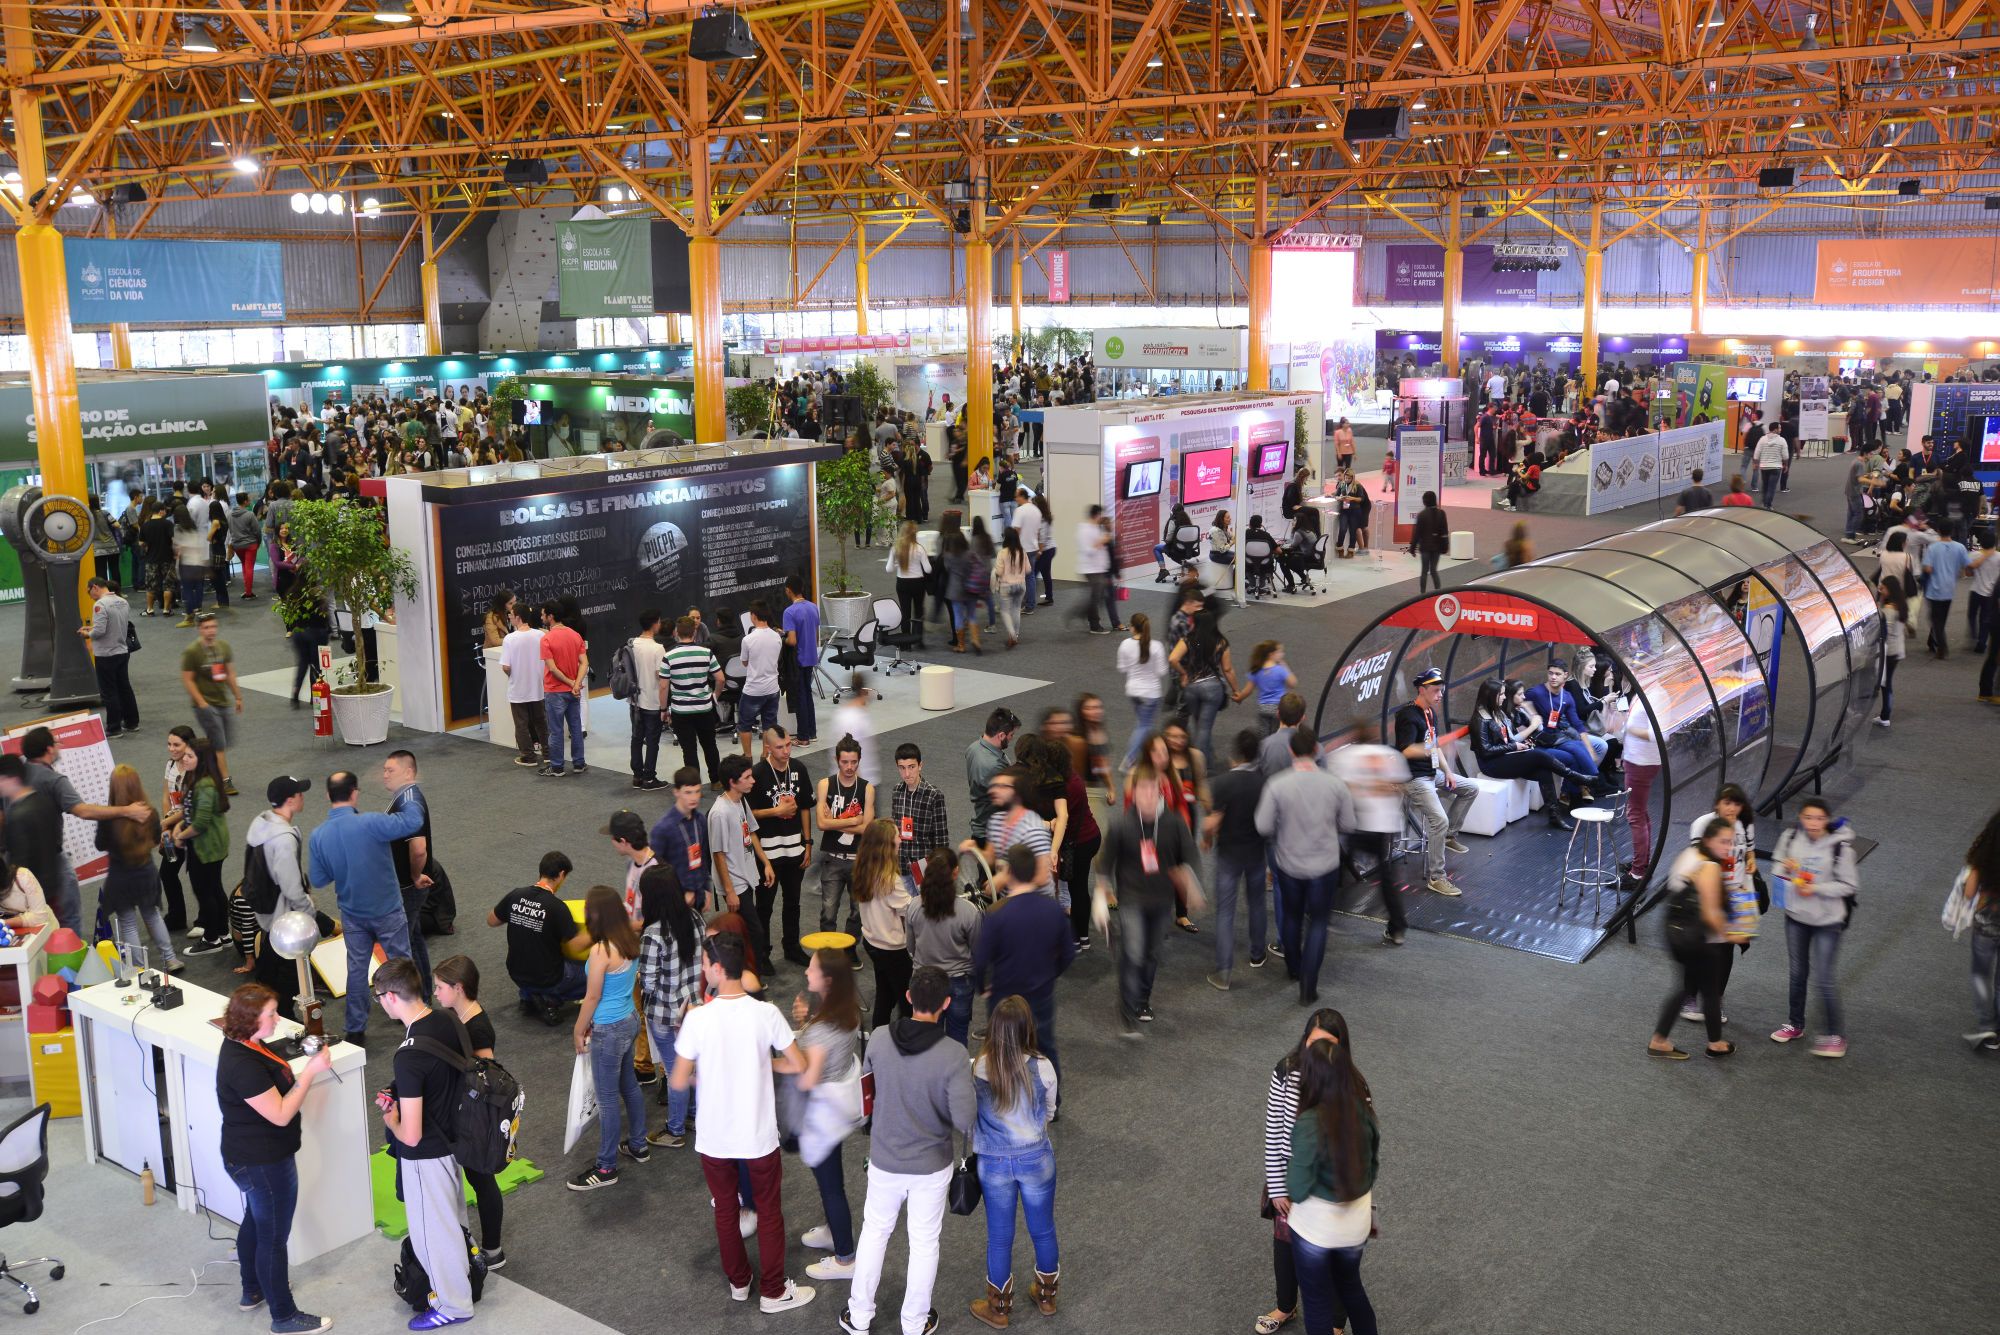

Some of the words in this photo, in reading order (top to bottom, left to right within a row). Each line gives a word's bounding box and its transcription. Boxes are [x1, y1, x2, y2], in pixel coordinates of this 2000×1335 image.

[582, 248, 603, 257] ESCOLA
[603, 248, 610, 256] DE
[108, 268, 132, 276] ESCOLA
[583, 260, 617, 271] MEDICINA
[1054, 253, 1063, 288] LOUNGE
[1852, 269, 1901, 277] ARQUITETURA
[109, 276, 147, 288] CIÊNCIAS
[1858, 278, 1885, 286] DESIGN
[110, 291, 122, 300] DA
[124, 291, 143, 300] VIDA
[379, 375, 434, 384] FISIOTERAPIA
[478, 368, 516, 379] NUTRIÇÃO
[301, 379, 345, 389] FARMÁCIA
[1181, 407, 1208, 416] PESQUISAS
[1257, 401, 1274, 409] FUTURO
[26, 410, 102, 426] CRO
[104, 409, 129, 422] DE
[27, 422, 137, 443] SLAÇÃO
[138, 419, 208, 434] CLÍNICA
[607, 471, 645, 484] BOLSAS
[645, 471, 651, 479] E
[651, 461, 729, 478] FINANCIAMENTOS
[499, 503, 584, 527] BOLSAS
[586, 499, 600, 515] E
[601, 477, 766, 513] FINANCIAMENTOS
[701, 507, 723, 519] CONHEÇA
[735, 503, 751, 514] SOBRE
[755, 499, 788, 511] PUCPR
[455, 542, 492, 559] CONHEÇA
[492, 541, 502, 553] AS
[502, 536, 531, 554] OPÇÕES
[532, 535, 542, 547] DE
[542, 531, 570, 546] BOLSAS
[570, 530, 580, 542] DE
[579, 526, 606, 541] ESTUDO
[644, 530, 677, 562] PUCPR
[456, 562, 462, 575] E
[462, 553, 527, 574] FINANCIAMENTOS
[523, 574, 554, 591] FUNDO
[557, 565, 601, 586] SOLIDÁRIO
[472, 581, 506, 599] PROUNI
[524, 587, 560, 605] BOLSAS
[1460, 608, 1534, 627] PUCTOUR
[1851, 625, 1866, 650] PUC
[60, 729, 81, 739] NÚMERO
[520, 897, 542, 908] PUCPR
